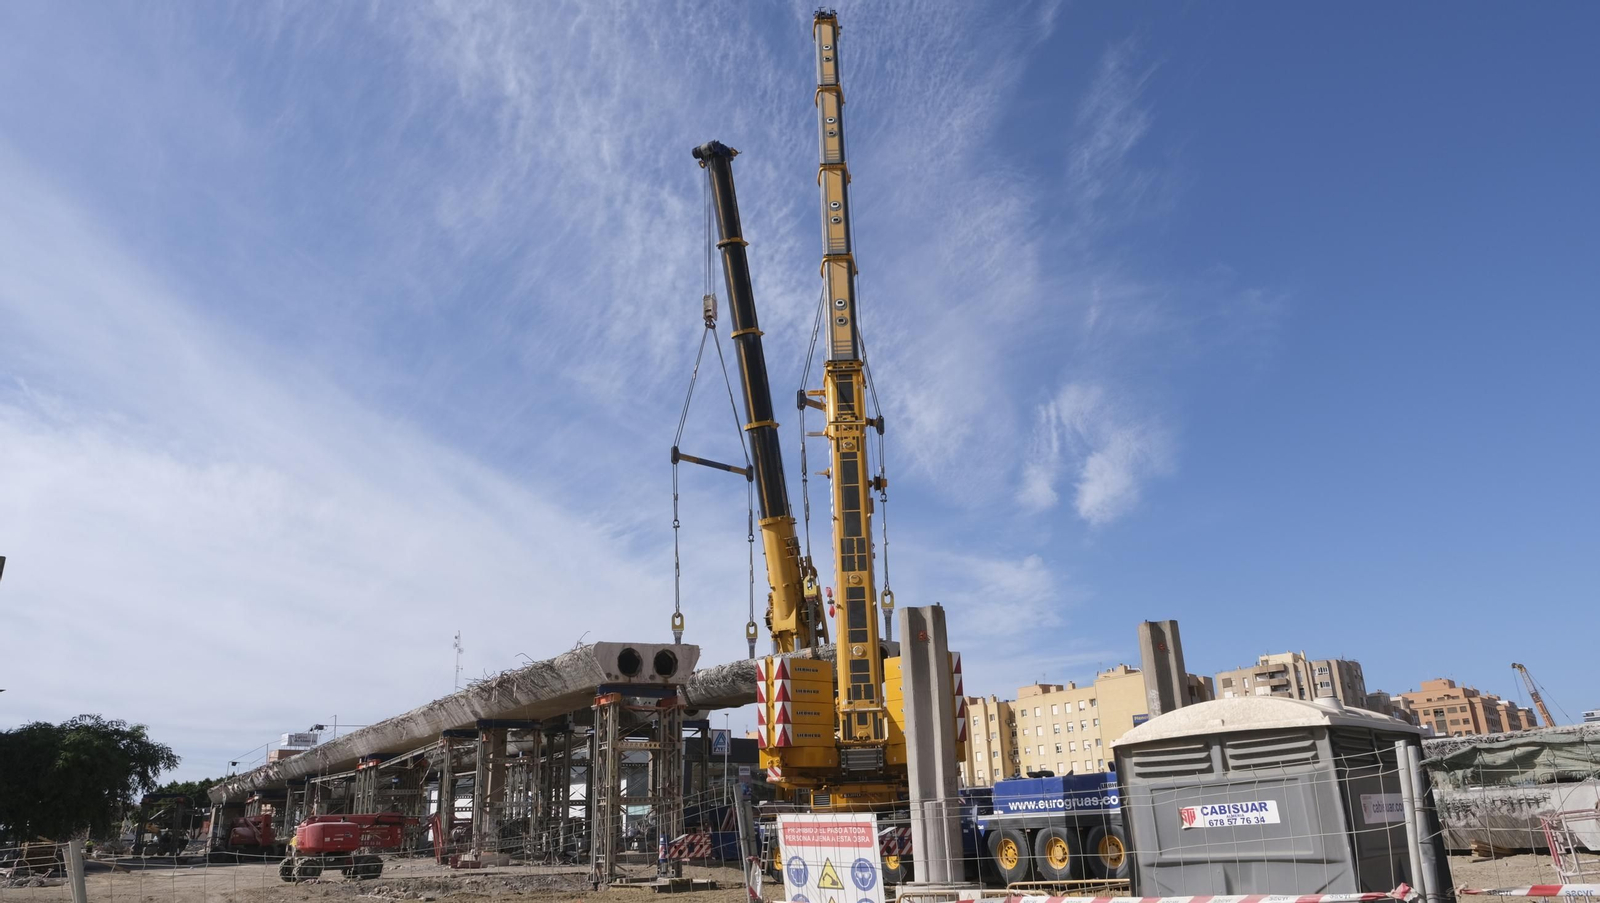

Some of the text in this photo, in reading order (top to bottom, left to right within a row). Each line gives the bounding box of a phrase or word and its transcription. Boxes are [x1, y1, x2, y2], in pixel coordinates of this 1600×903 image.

[1200, 801, 1269, 816] CABISUAR
[1208, 816, 1266, 827] 678 57 76 34
